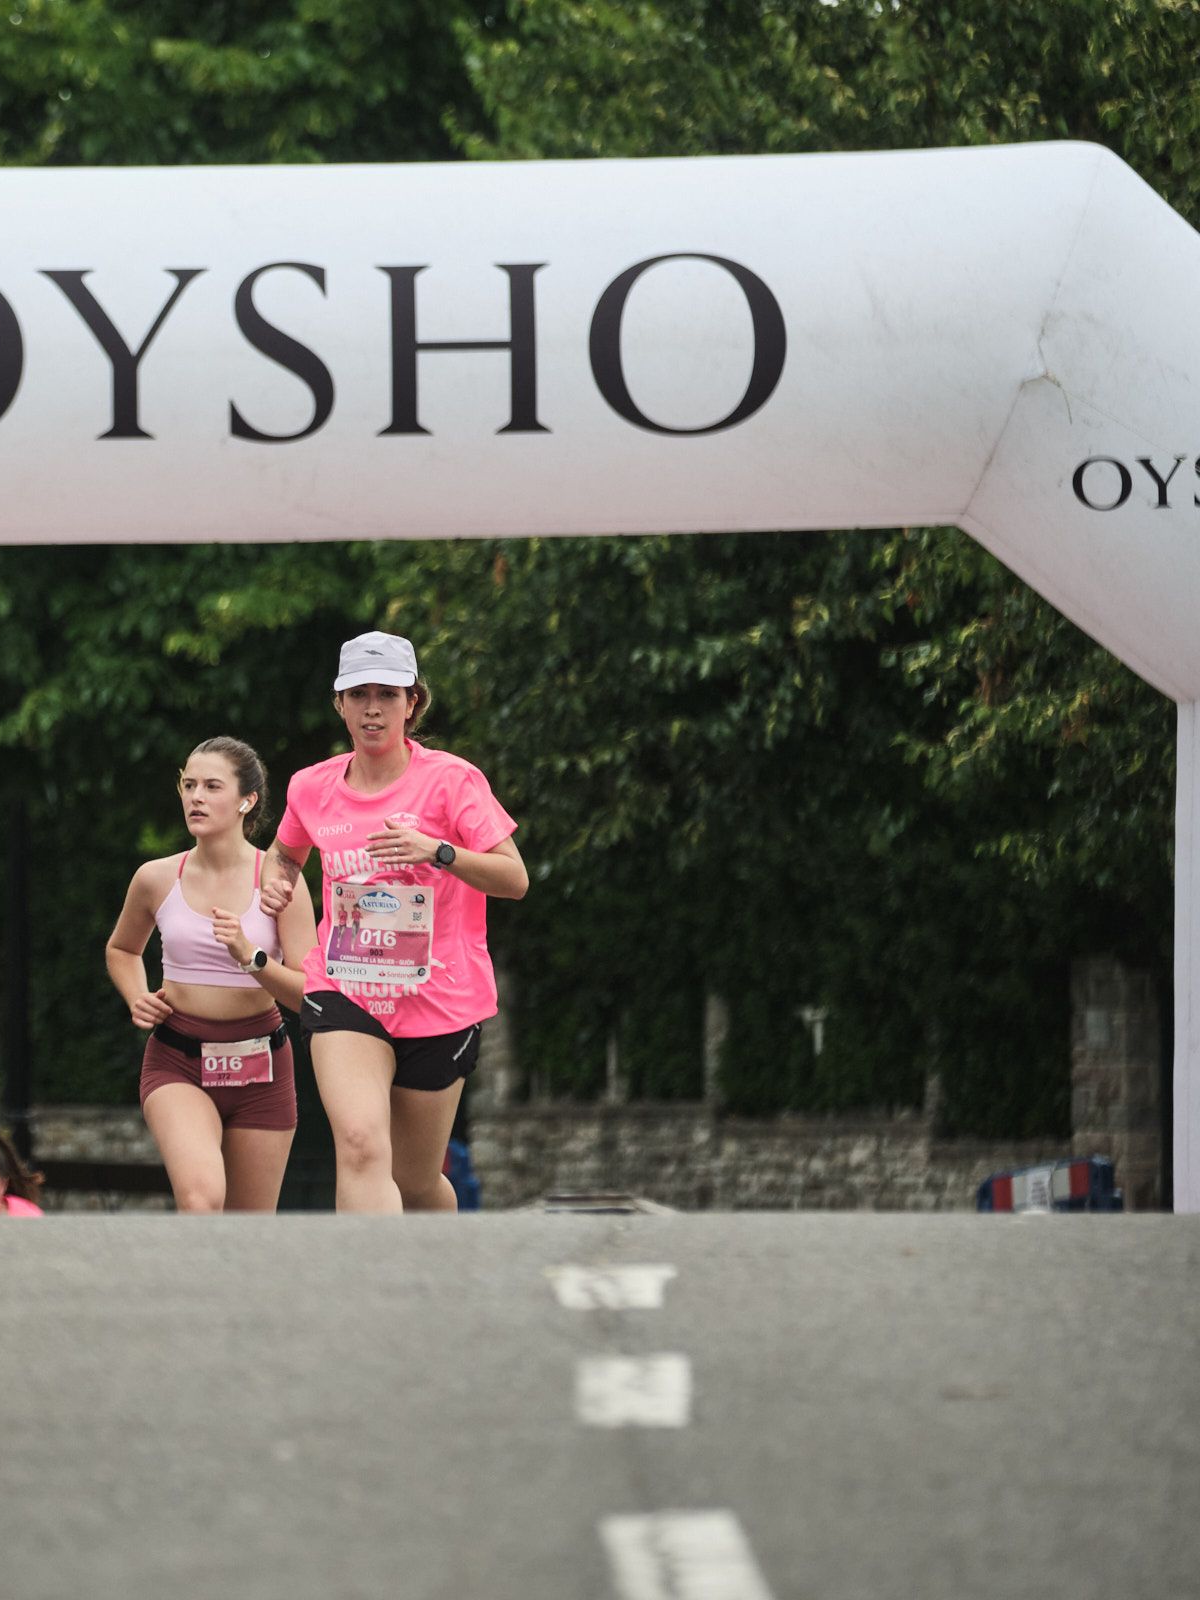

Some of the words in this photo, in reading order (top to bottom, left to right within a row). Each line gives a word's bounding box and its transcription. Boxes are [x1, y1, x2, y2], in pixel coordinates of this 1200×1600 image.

[1072, 455, 1200, 511] OY
[317, 822, 353, 837] OYSHO
[360, 928, 397, 947] 016
[339, 954, 362, 962] CARRERA
[377, 957, 396, 965] MUJER
[369, 948, 384, 957] 903
[335, 965, 367, 976] OYSHO
[204, 1056, 243, 1071] 016
